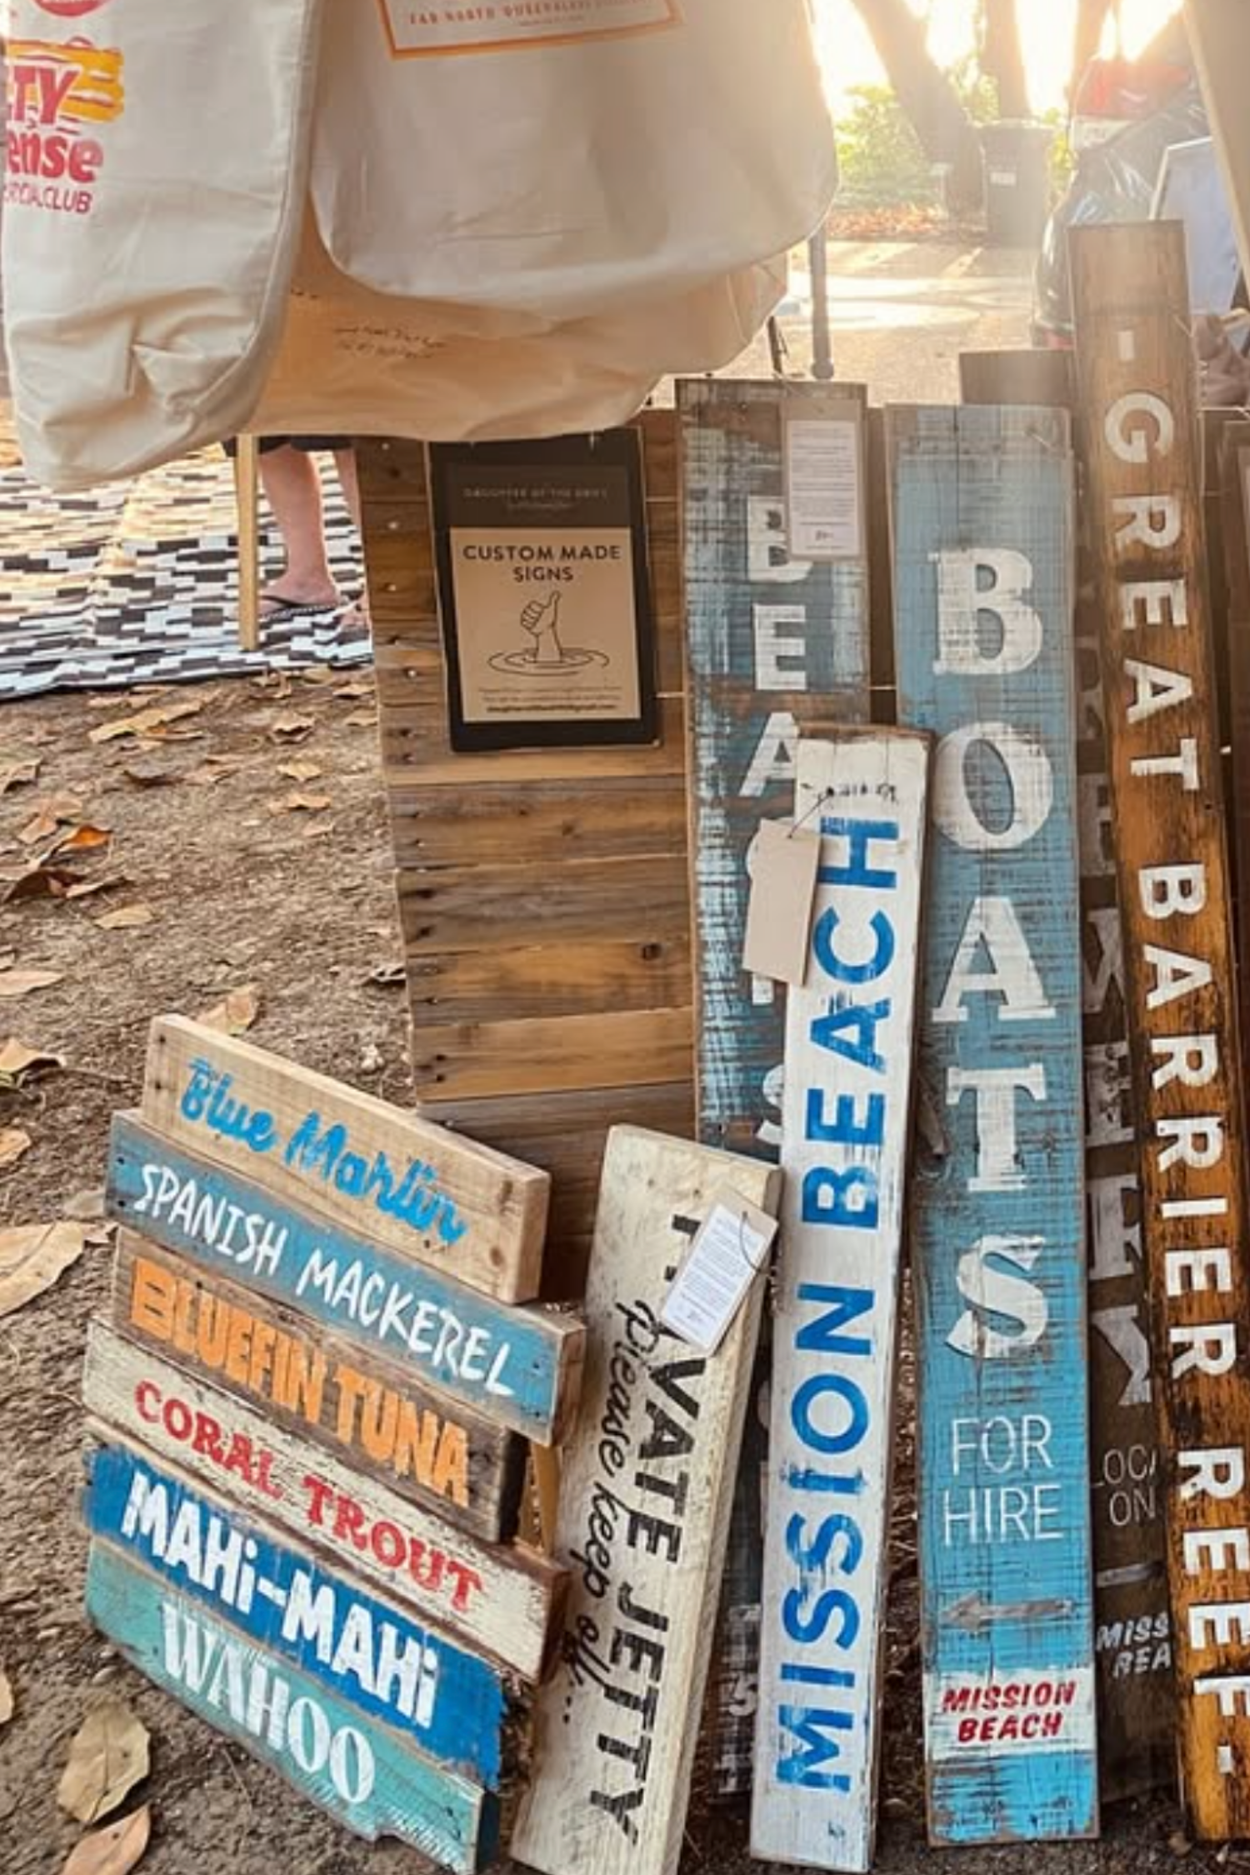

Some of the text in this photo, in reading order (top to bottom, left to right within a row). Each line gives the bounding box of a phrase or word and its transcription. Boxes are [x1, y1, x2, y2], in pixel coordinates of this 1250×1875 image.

[8, 65, 81, 124] TY
[8, 130, 104, 184] ense
[462, 545, 621, 561] CUSTOM MADE
[512, 565, 574, 583] SIGNS
[927, 546, 1058, 1360] BOATS
[180, 1056, 468, 1247] Blue Marlin
[1138, 863, 1237, 1379] BARRIER
[133, 1164, 514, 1397] SPANISH MACKEREL
[776, 815, 900, 1792] MISSION BEACH
[131, 1258, 470, 1508] BLUEFIN TUNA
[597, 1298, 662, 1480] please
[949, 1412, 1054, 1475] FOR
[133, 1380, 482, 1614] CORAL TROUT
[568, 1478, 627, 1601] keep
[941, 1485, 1065, 1547] HIRE
[1108, 1484, 1157, 1527] ON
[1096, 1612, 1170, 1651] MISS
[1113, 1643, 1172, 1679] BEA
[162, 1601, 375, 1806] WAHOO
[590, 1580, 669, 1847] JETTY
[940, 1678, 1078, 1714] MISSION
[957, 1710, 1064, 1744] BEACH
